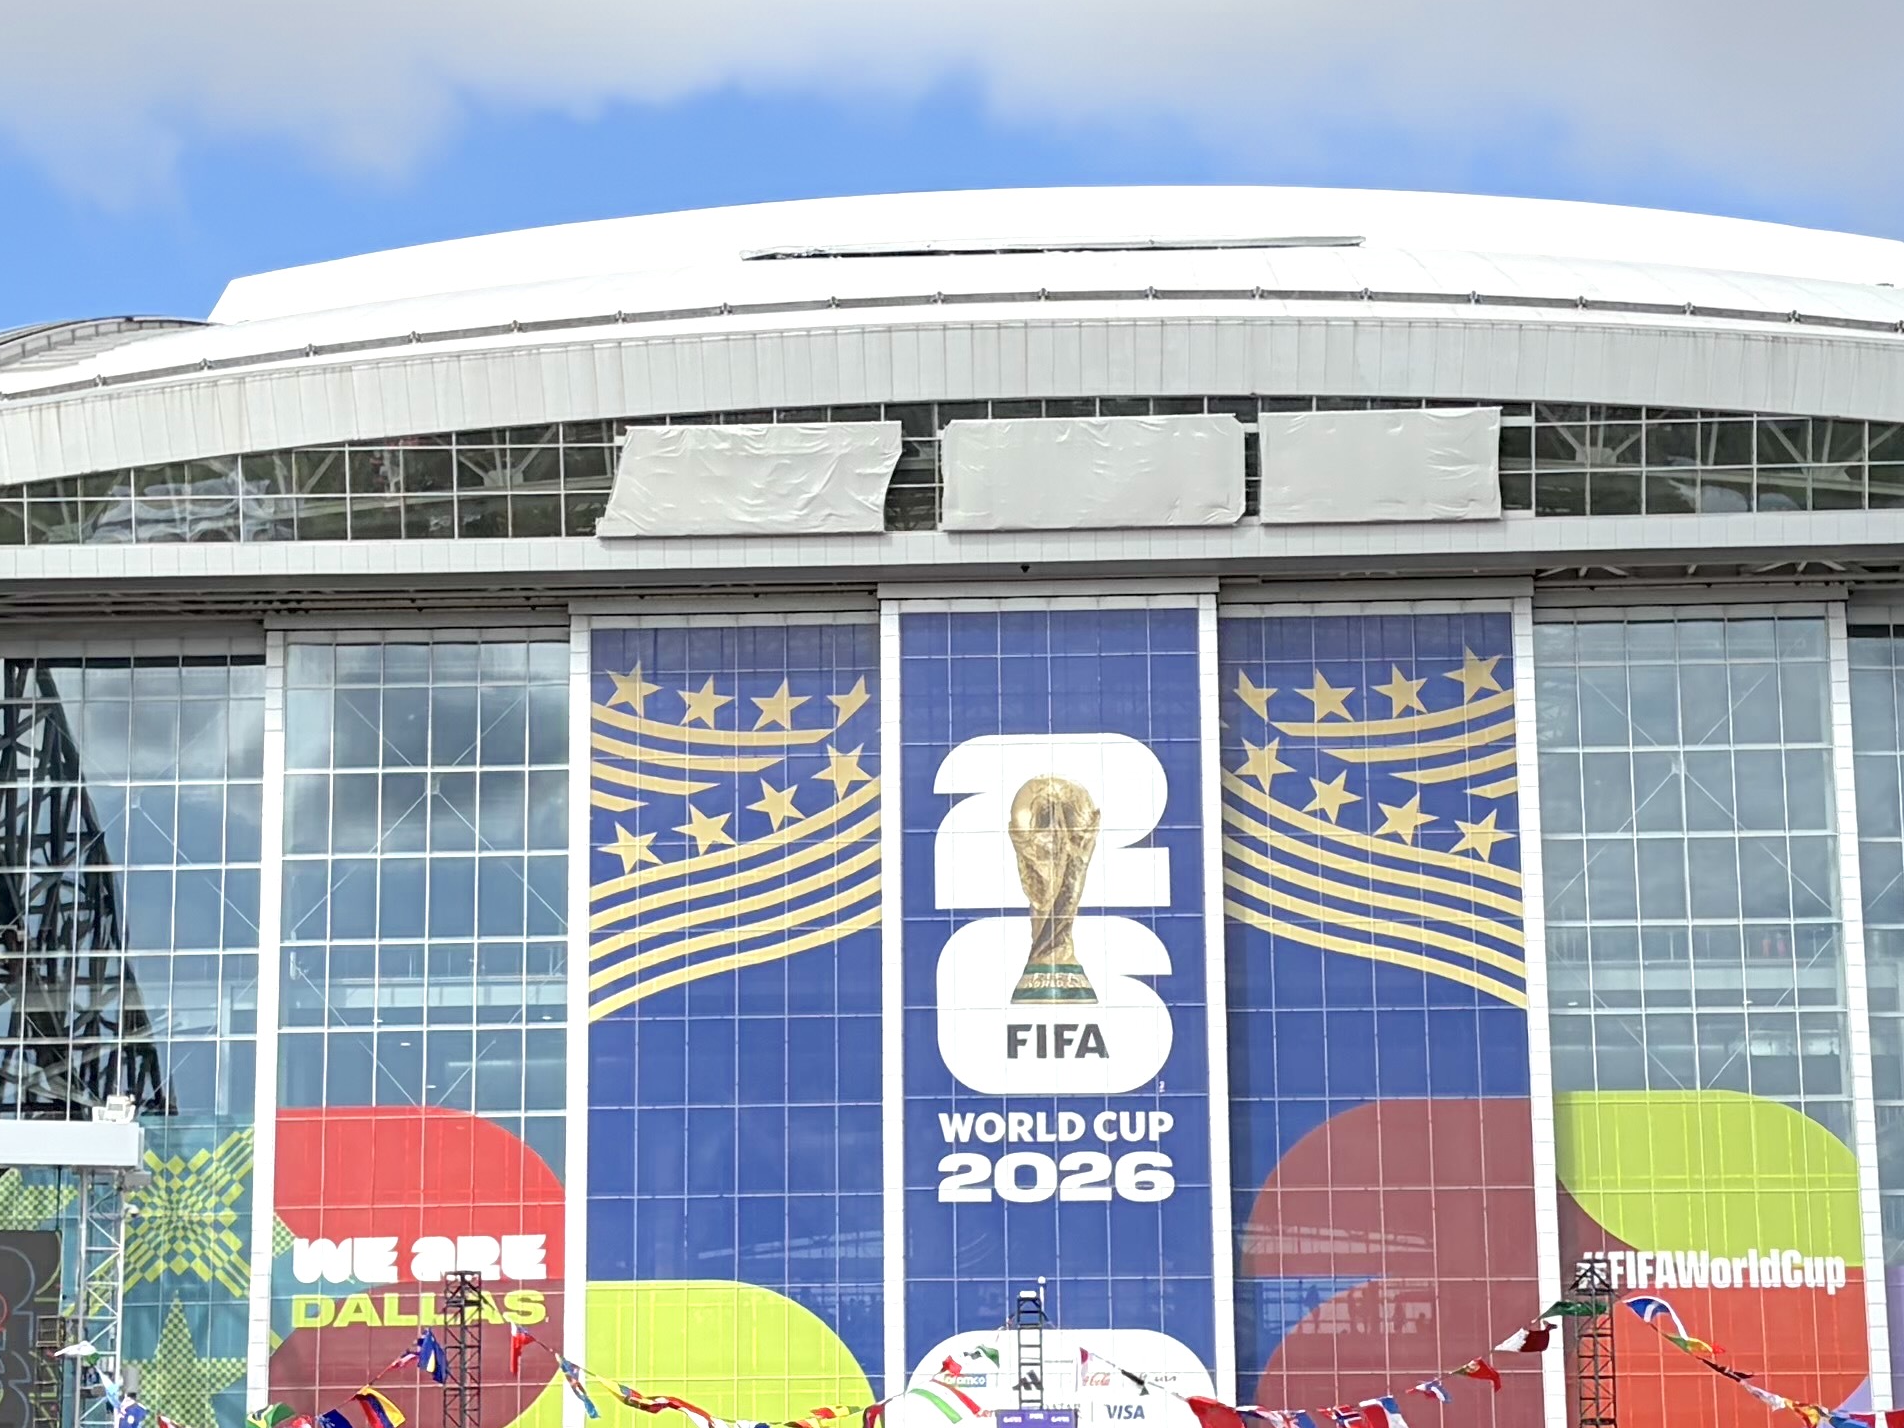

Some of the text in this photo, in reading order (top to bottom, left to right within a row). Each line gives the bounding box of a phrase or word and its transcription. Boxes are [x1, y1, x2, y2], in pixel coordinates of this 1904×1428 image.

[1007, 1024, 1109, 1059] FIFA
[938, 1111, 1174, 1143] WORLD CUP
[937, 1151, 1175, 1203] 2026
[1576, 1248, 1846, 1295] #FIFAWorldCup
[292, 1289, 547, 1329] DALLAS
[1105, 1405, 1146, 1420] VISA
